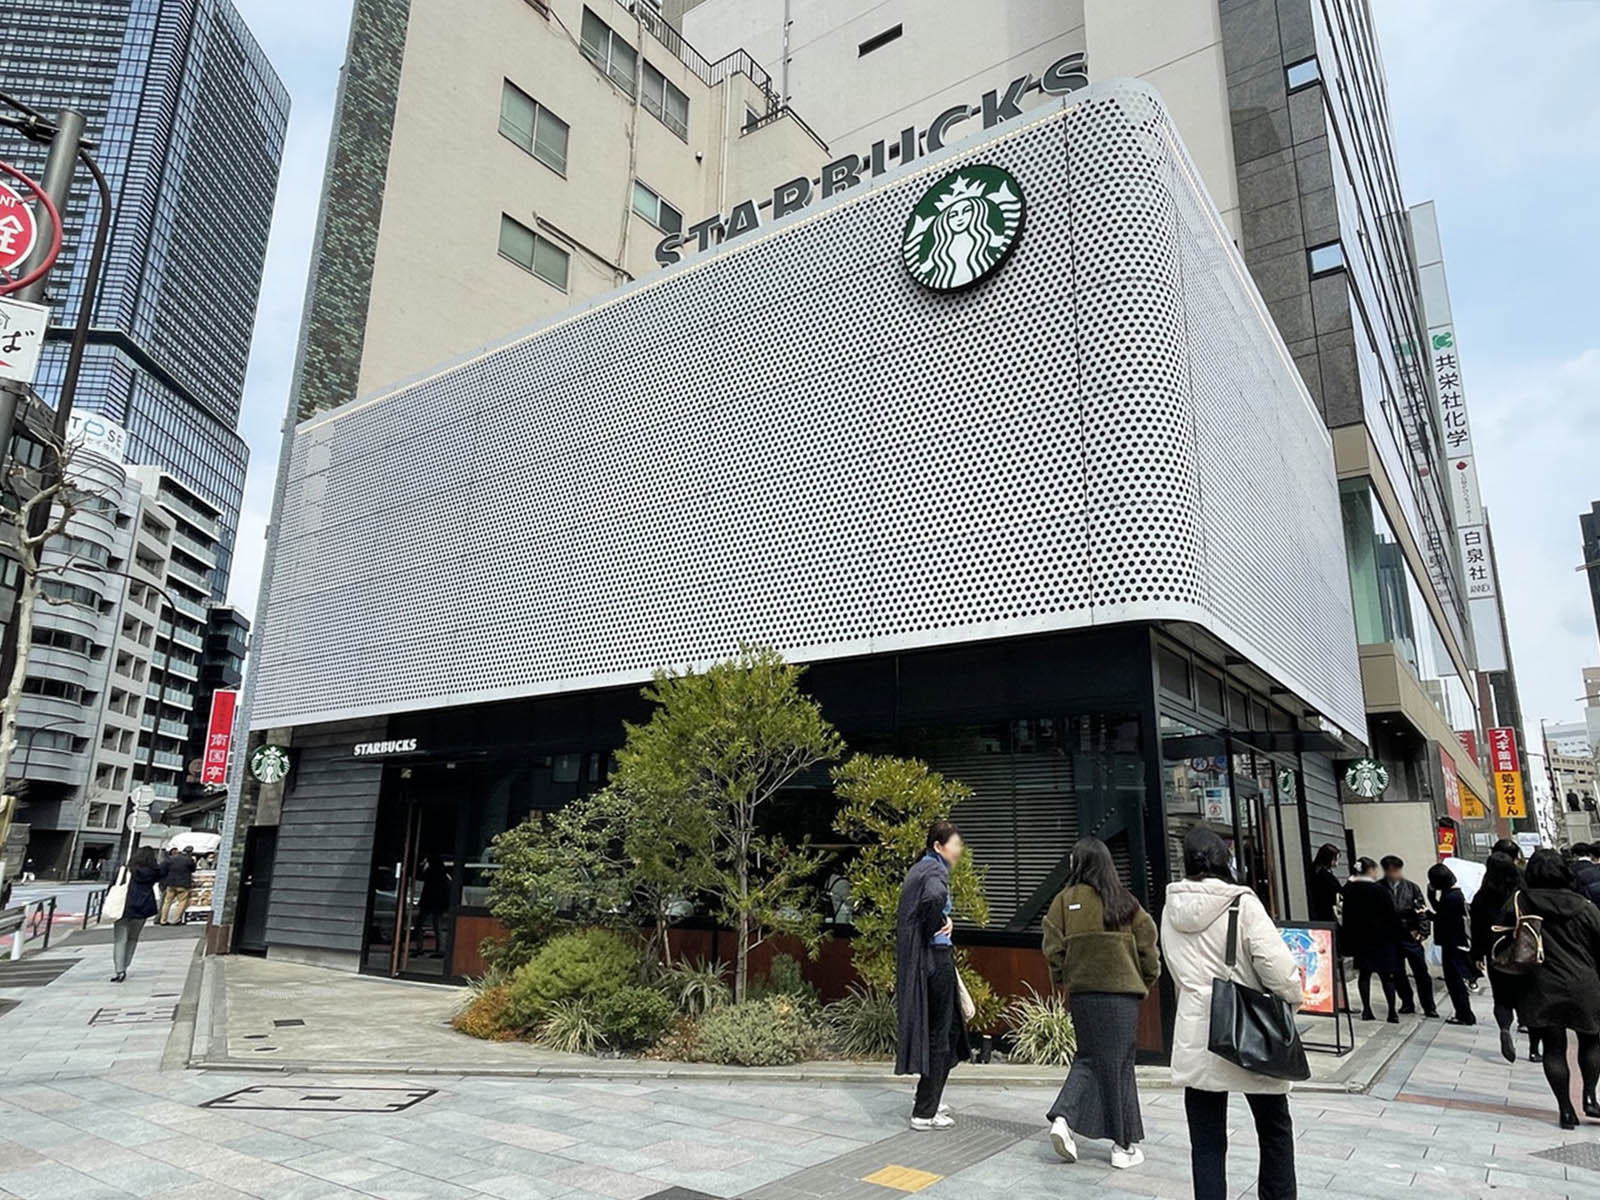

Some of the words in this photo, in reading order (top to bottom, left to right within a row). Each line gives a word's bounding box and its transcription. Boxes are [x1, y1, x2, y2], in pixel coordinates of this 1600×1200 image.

[655, 50, 1091, 269] STARBUCKS
[1435, 353, 1469, 448] 共栄社化学
[1464, 531, 1488, 580] 白泉社
[353, 738, 417, 756] STARBUCKS
[1501, 773, 1519, 816] 処方せん
